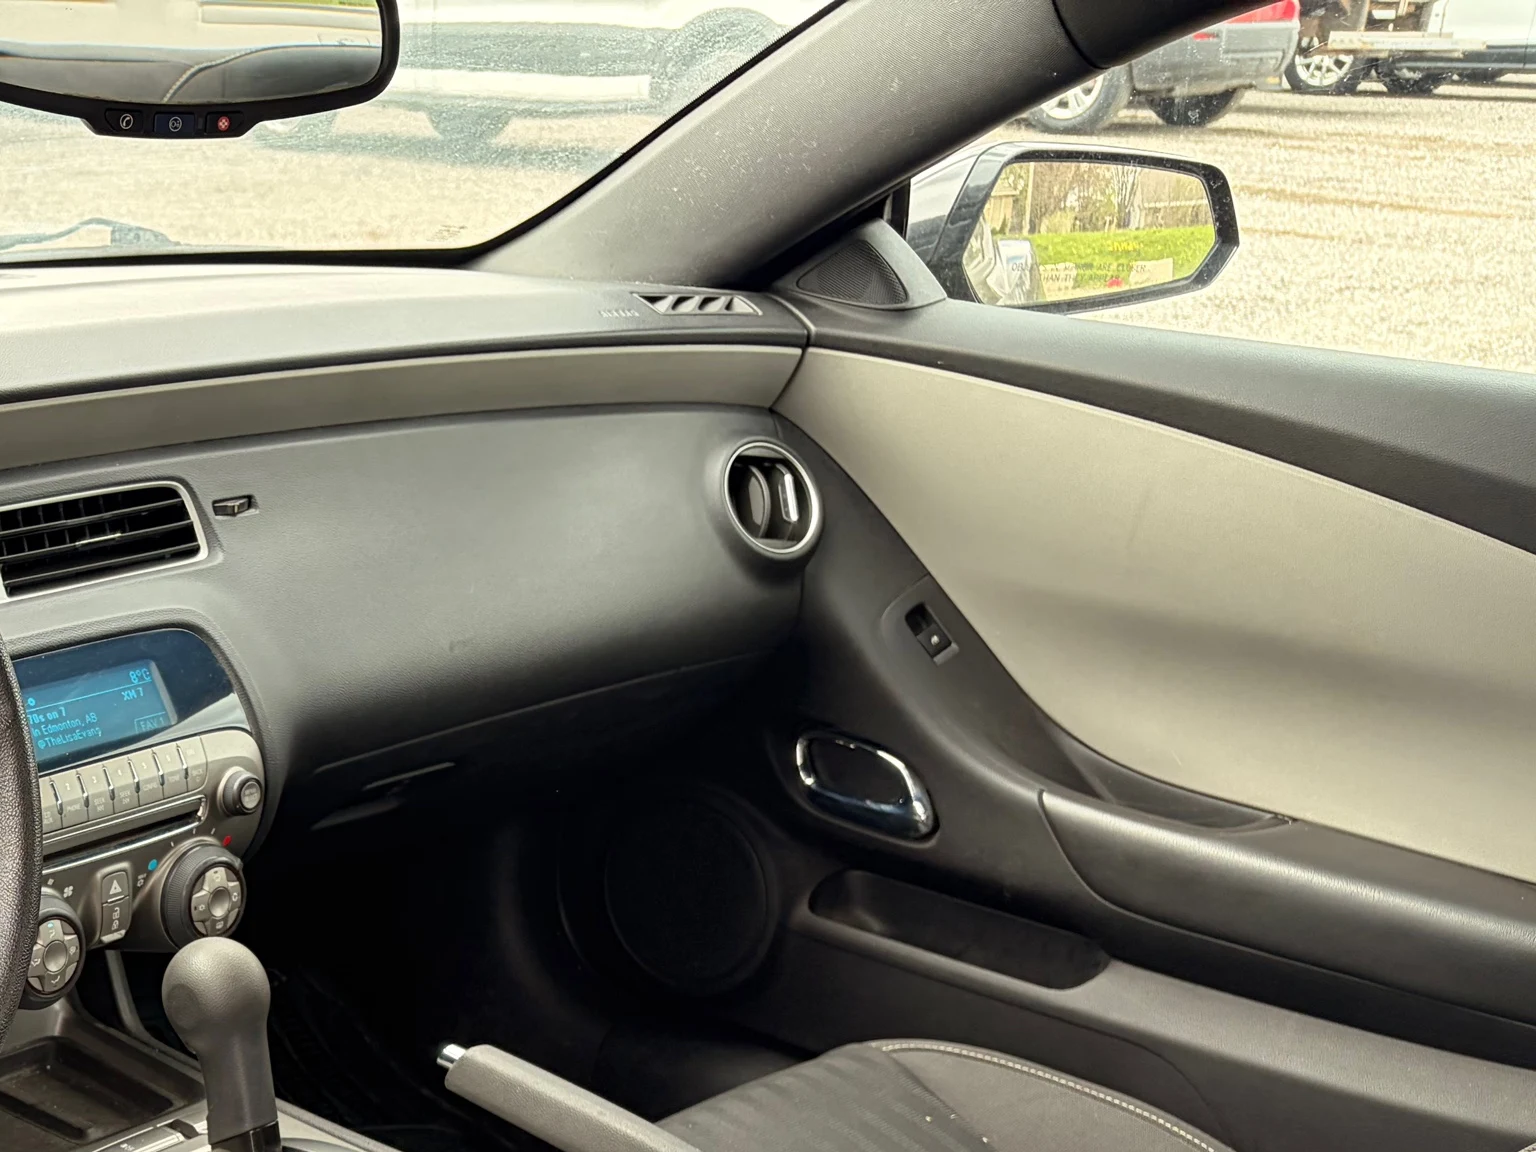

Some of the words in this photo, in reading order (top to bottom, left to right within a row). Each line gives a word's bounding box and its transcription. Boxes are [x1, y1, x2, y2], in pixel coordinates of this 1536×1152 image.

[46, 711, 59, 721] on
[59, 706, 67, 717] 7
[41, 718, 85, 735] Edmonton,
[85, 712, 98, 724] AB
